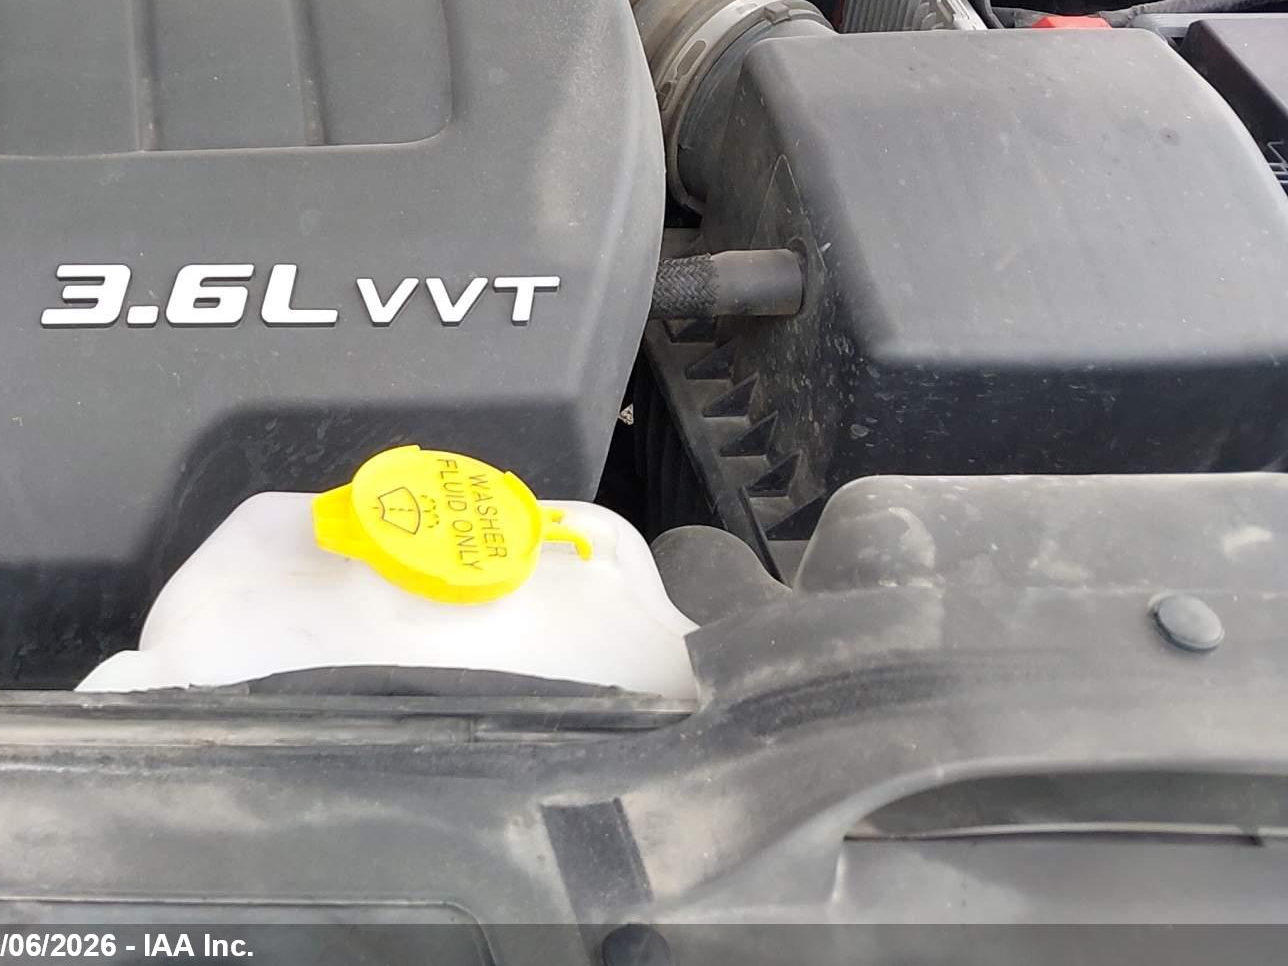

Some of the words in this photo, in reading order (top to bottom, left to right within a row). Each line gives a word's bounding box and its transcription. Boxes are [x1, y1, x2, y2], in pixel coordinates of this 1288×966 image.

[40, 264, 339, 328] 3.6L
[355, 276, 561, 327] VVT
[436, 458, 469, 512] FLUID
[452, 519, 484, 571] ONLY
[468, 473, 509, 559] WASHER
